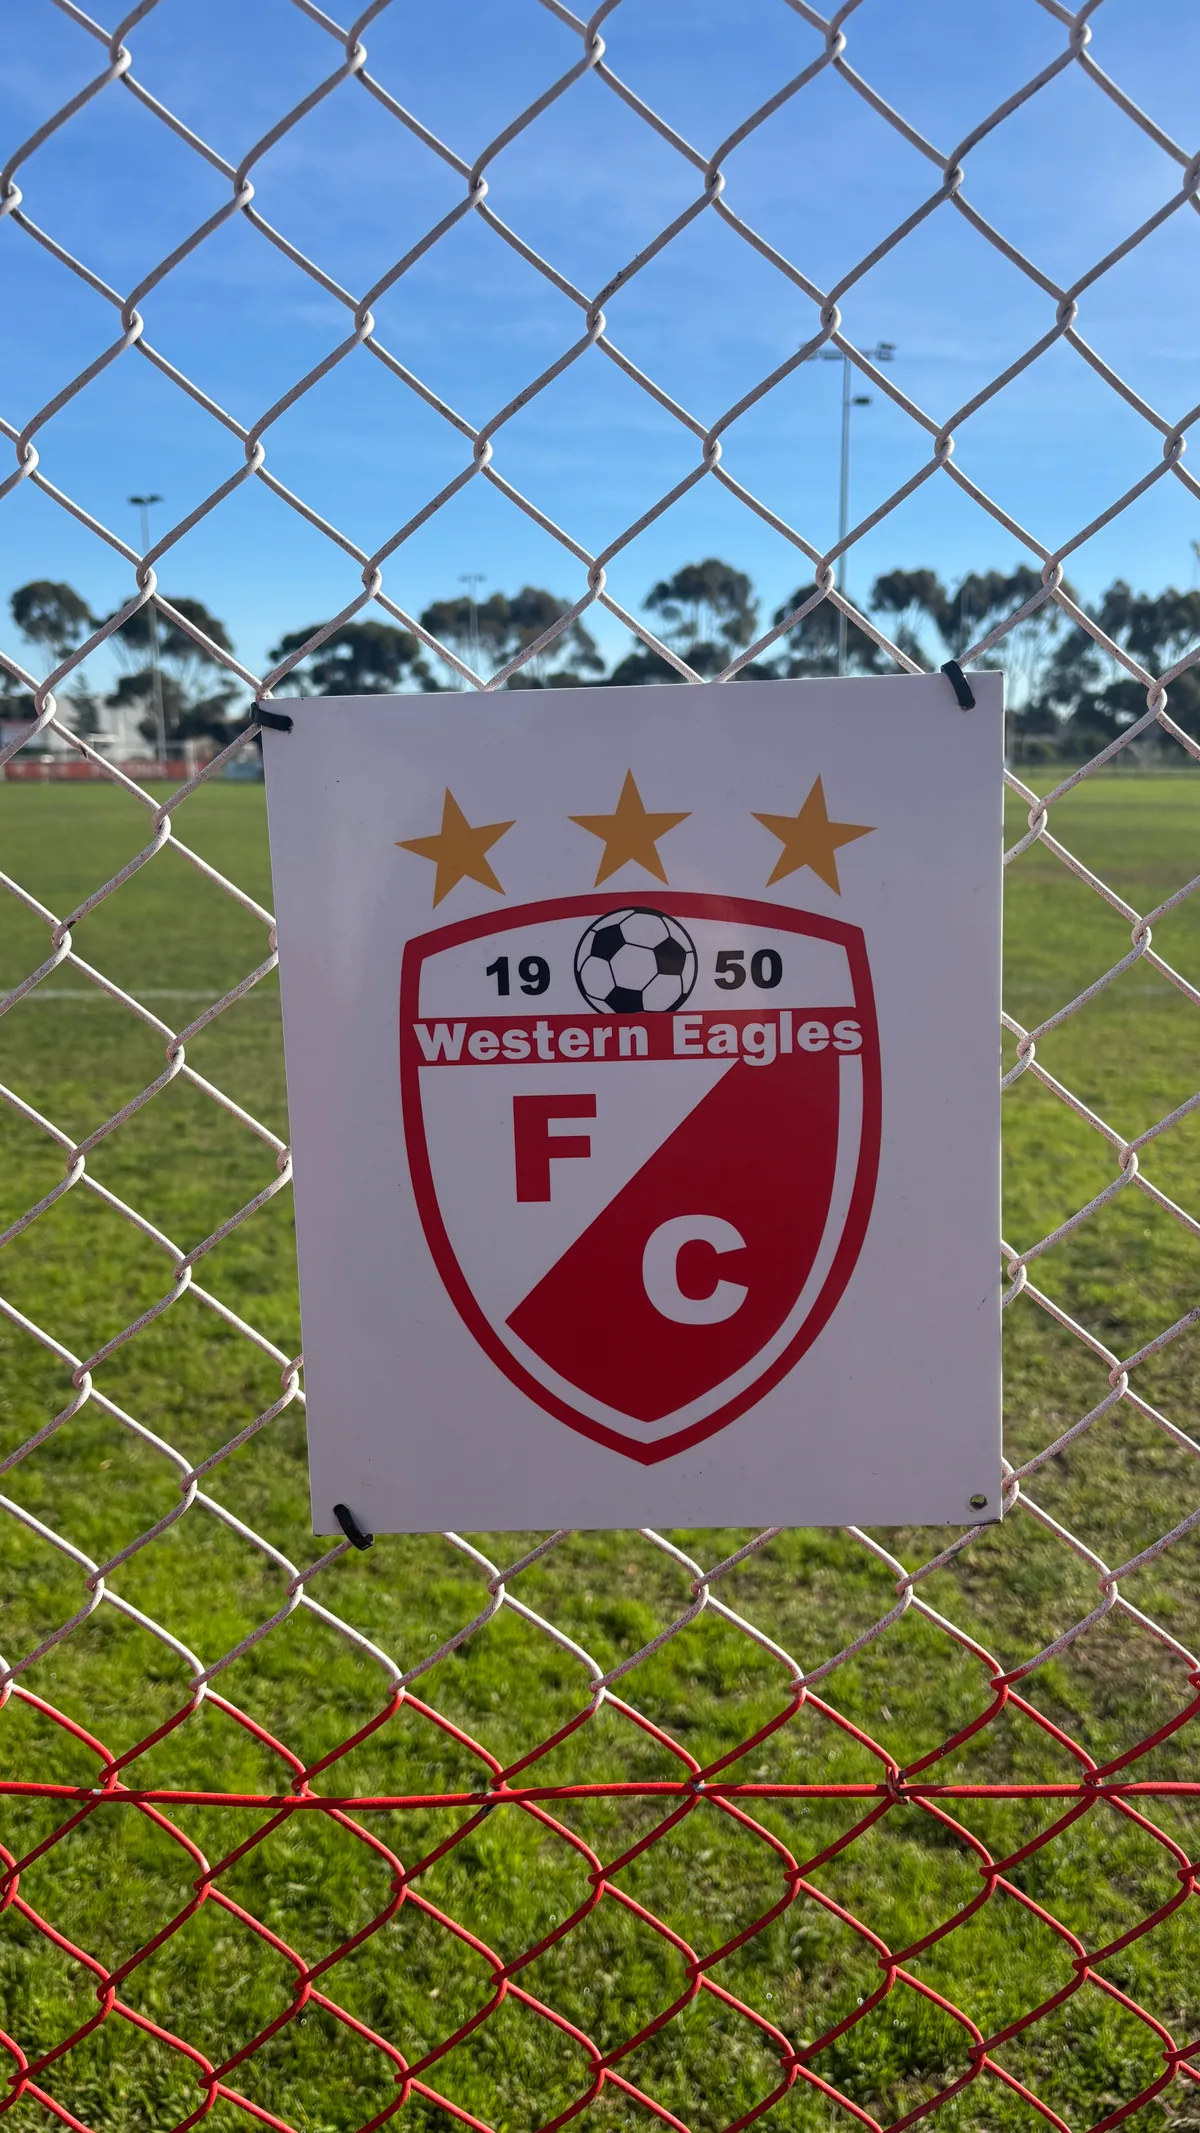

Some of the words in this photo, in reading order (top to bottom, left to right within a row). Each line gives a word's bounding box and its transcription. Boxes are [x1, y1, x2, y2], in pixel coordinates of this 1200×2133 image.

[486, 955, 551, 996] 19
[713, 949, 783, 990] 50
[413, 1021, 649, 1062] Western
[672, 1011, 863, 1066] Eagles
[512, 1093, 597, 1203] F
[642, 1213, 749, 1325] C
